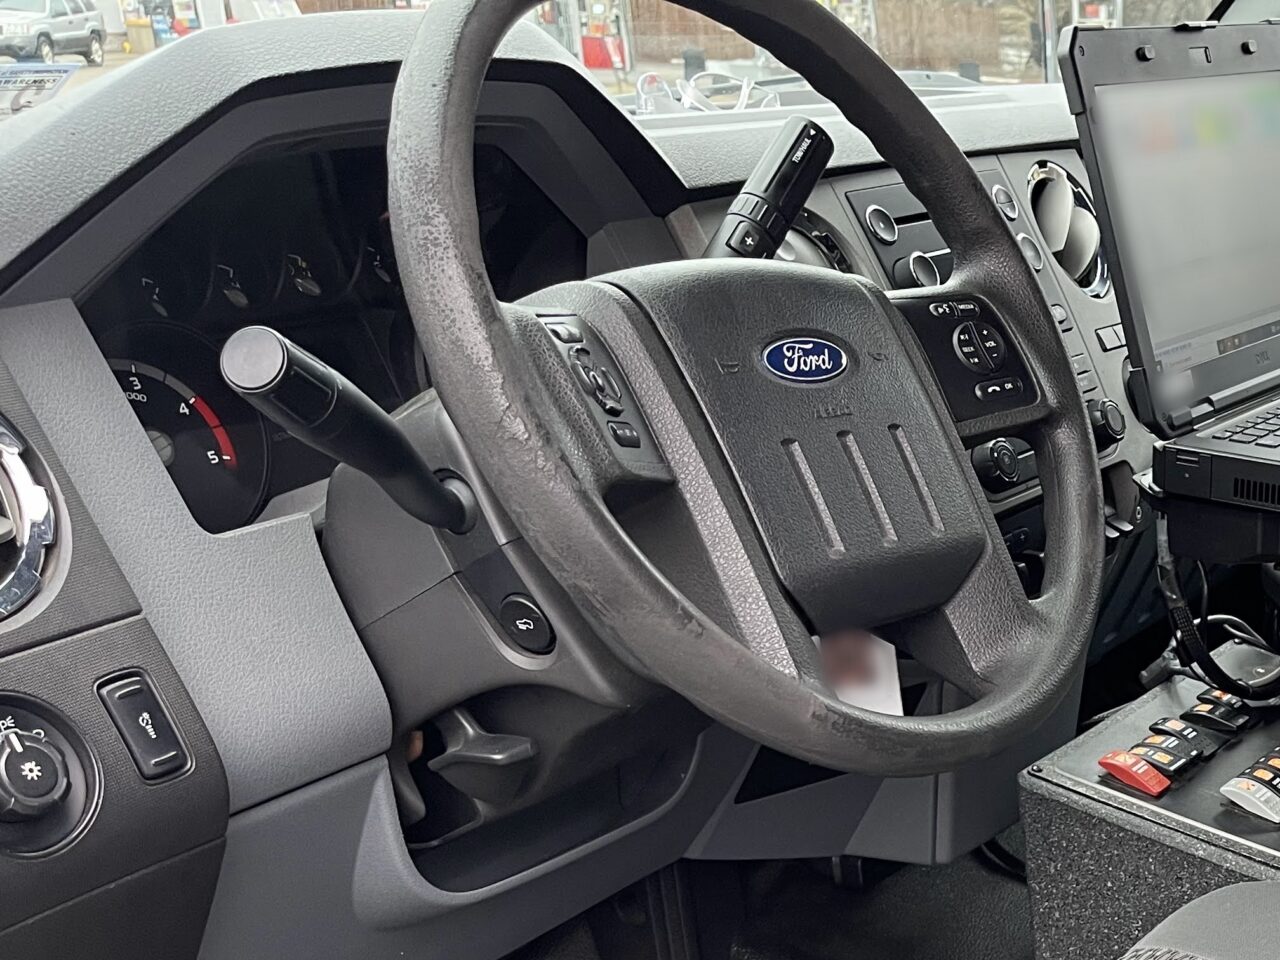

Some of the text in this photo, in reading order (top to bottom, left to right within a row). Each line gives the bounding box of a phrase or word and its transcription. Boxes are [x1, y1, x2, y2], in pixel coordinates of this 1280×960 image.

[984, 340, 997, 348] VOL
[782, 343, 833, 373] Ford
[129, 376, 142, 391] 3
[179, 402, 190, 416] 4
[206, 450, 219, 464] 5
